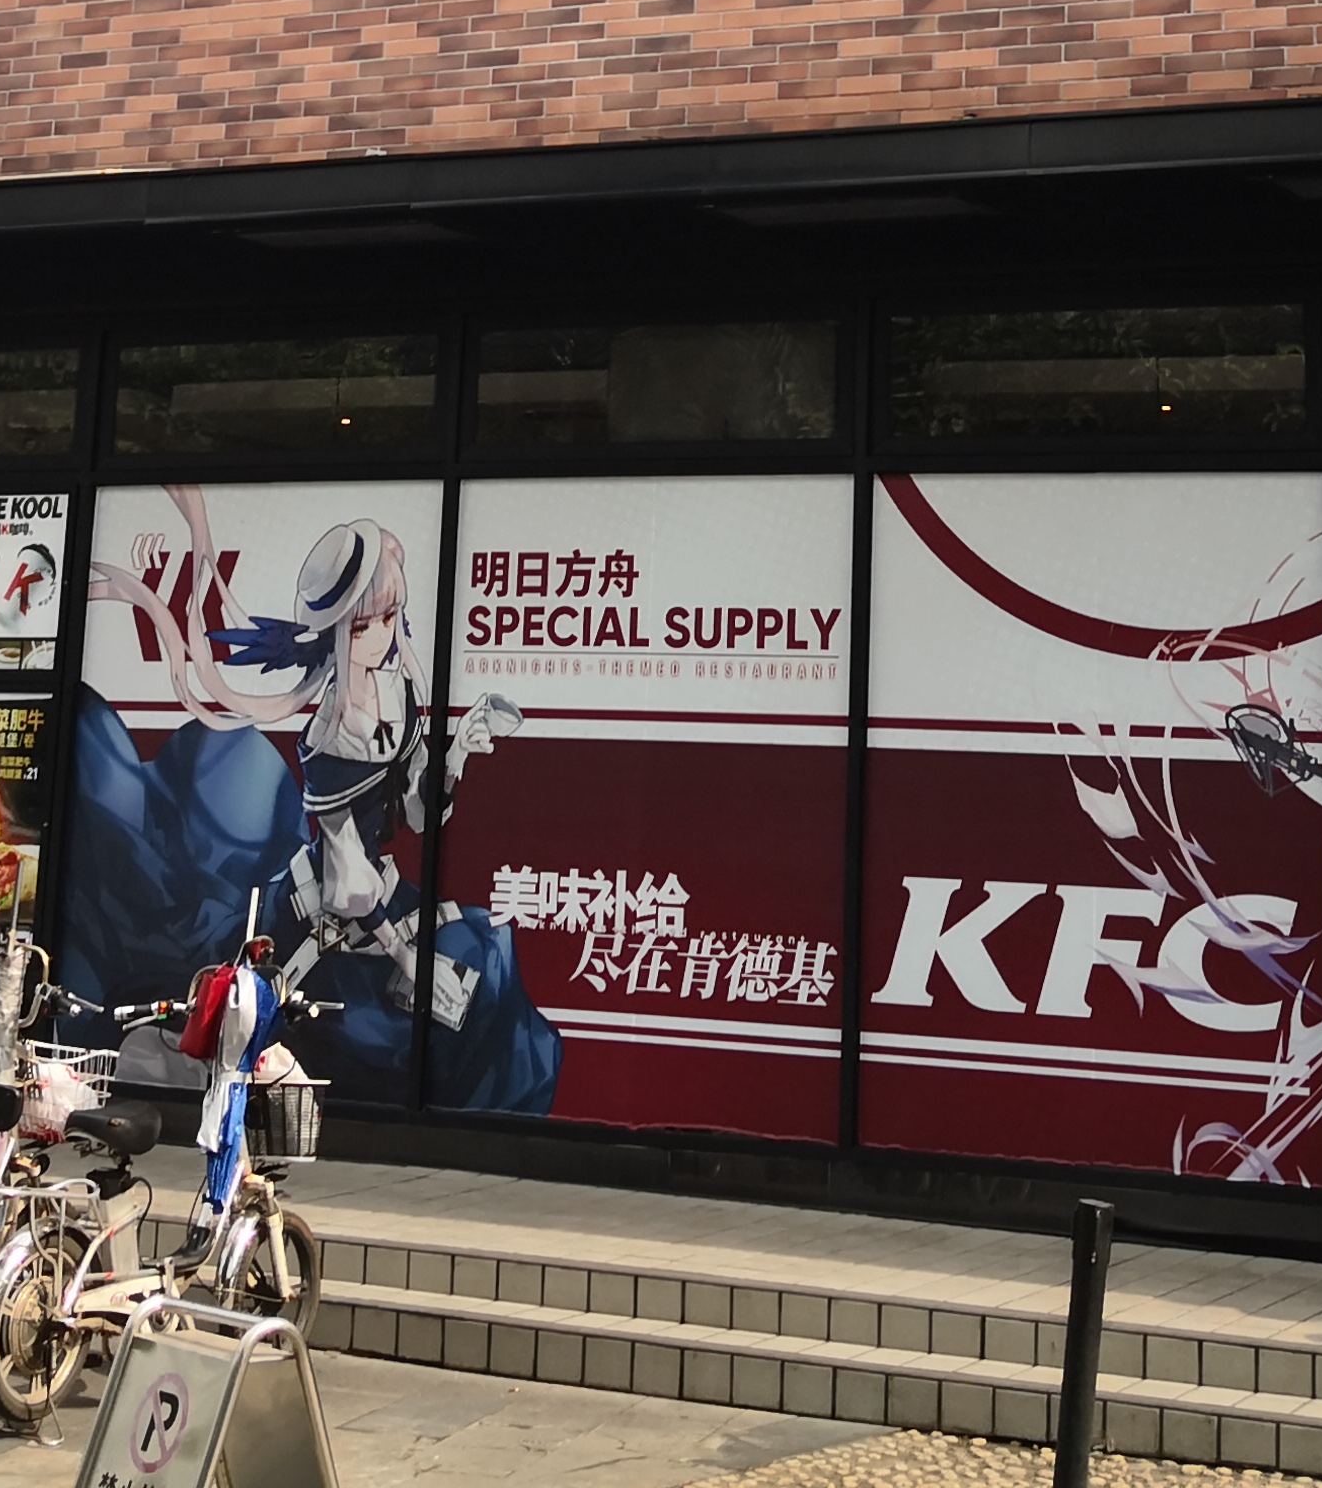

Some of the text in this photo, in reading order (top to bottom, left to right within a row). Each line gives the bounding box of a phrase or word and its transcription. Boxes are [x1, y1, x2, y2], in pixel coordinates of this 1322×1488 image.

[10, 496, 64, 520] KOOL
[470, 548, 640, 599] 明日方舟
[465, 605, 842, 651] SPECIAL SUPPLY
[464, 658, 839, 681] ARKNIGHTS-THEMED RESTAURANT
[489, 864, 691, 938] 美味补给
[570, 931, 839, 1007] 尽在肯德基
[870, 876, 1299, 1033] KFC
[140, 1389, 180, 1452] P
